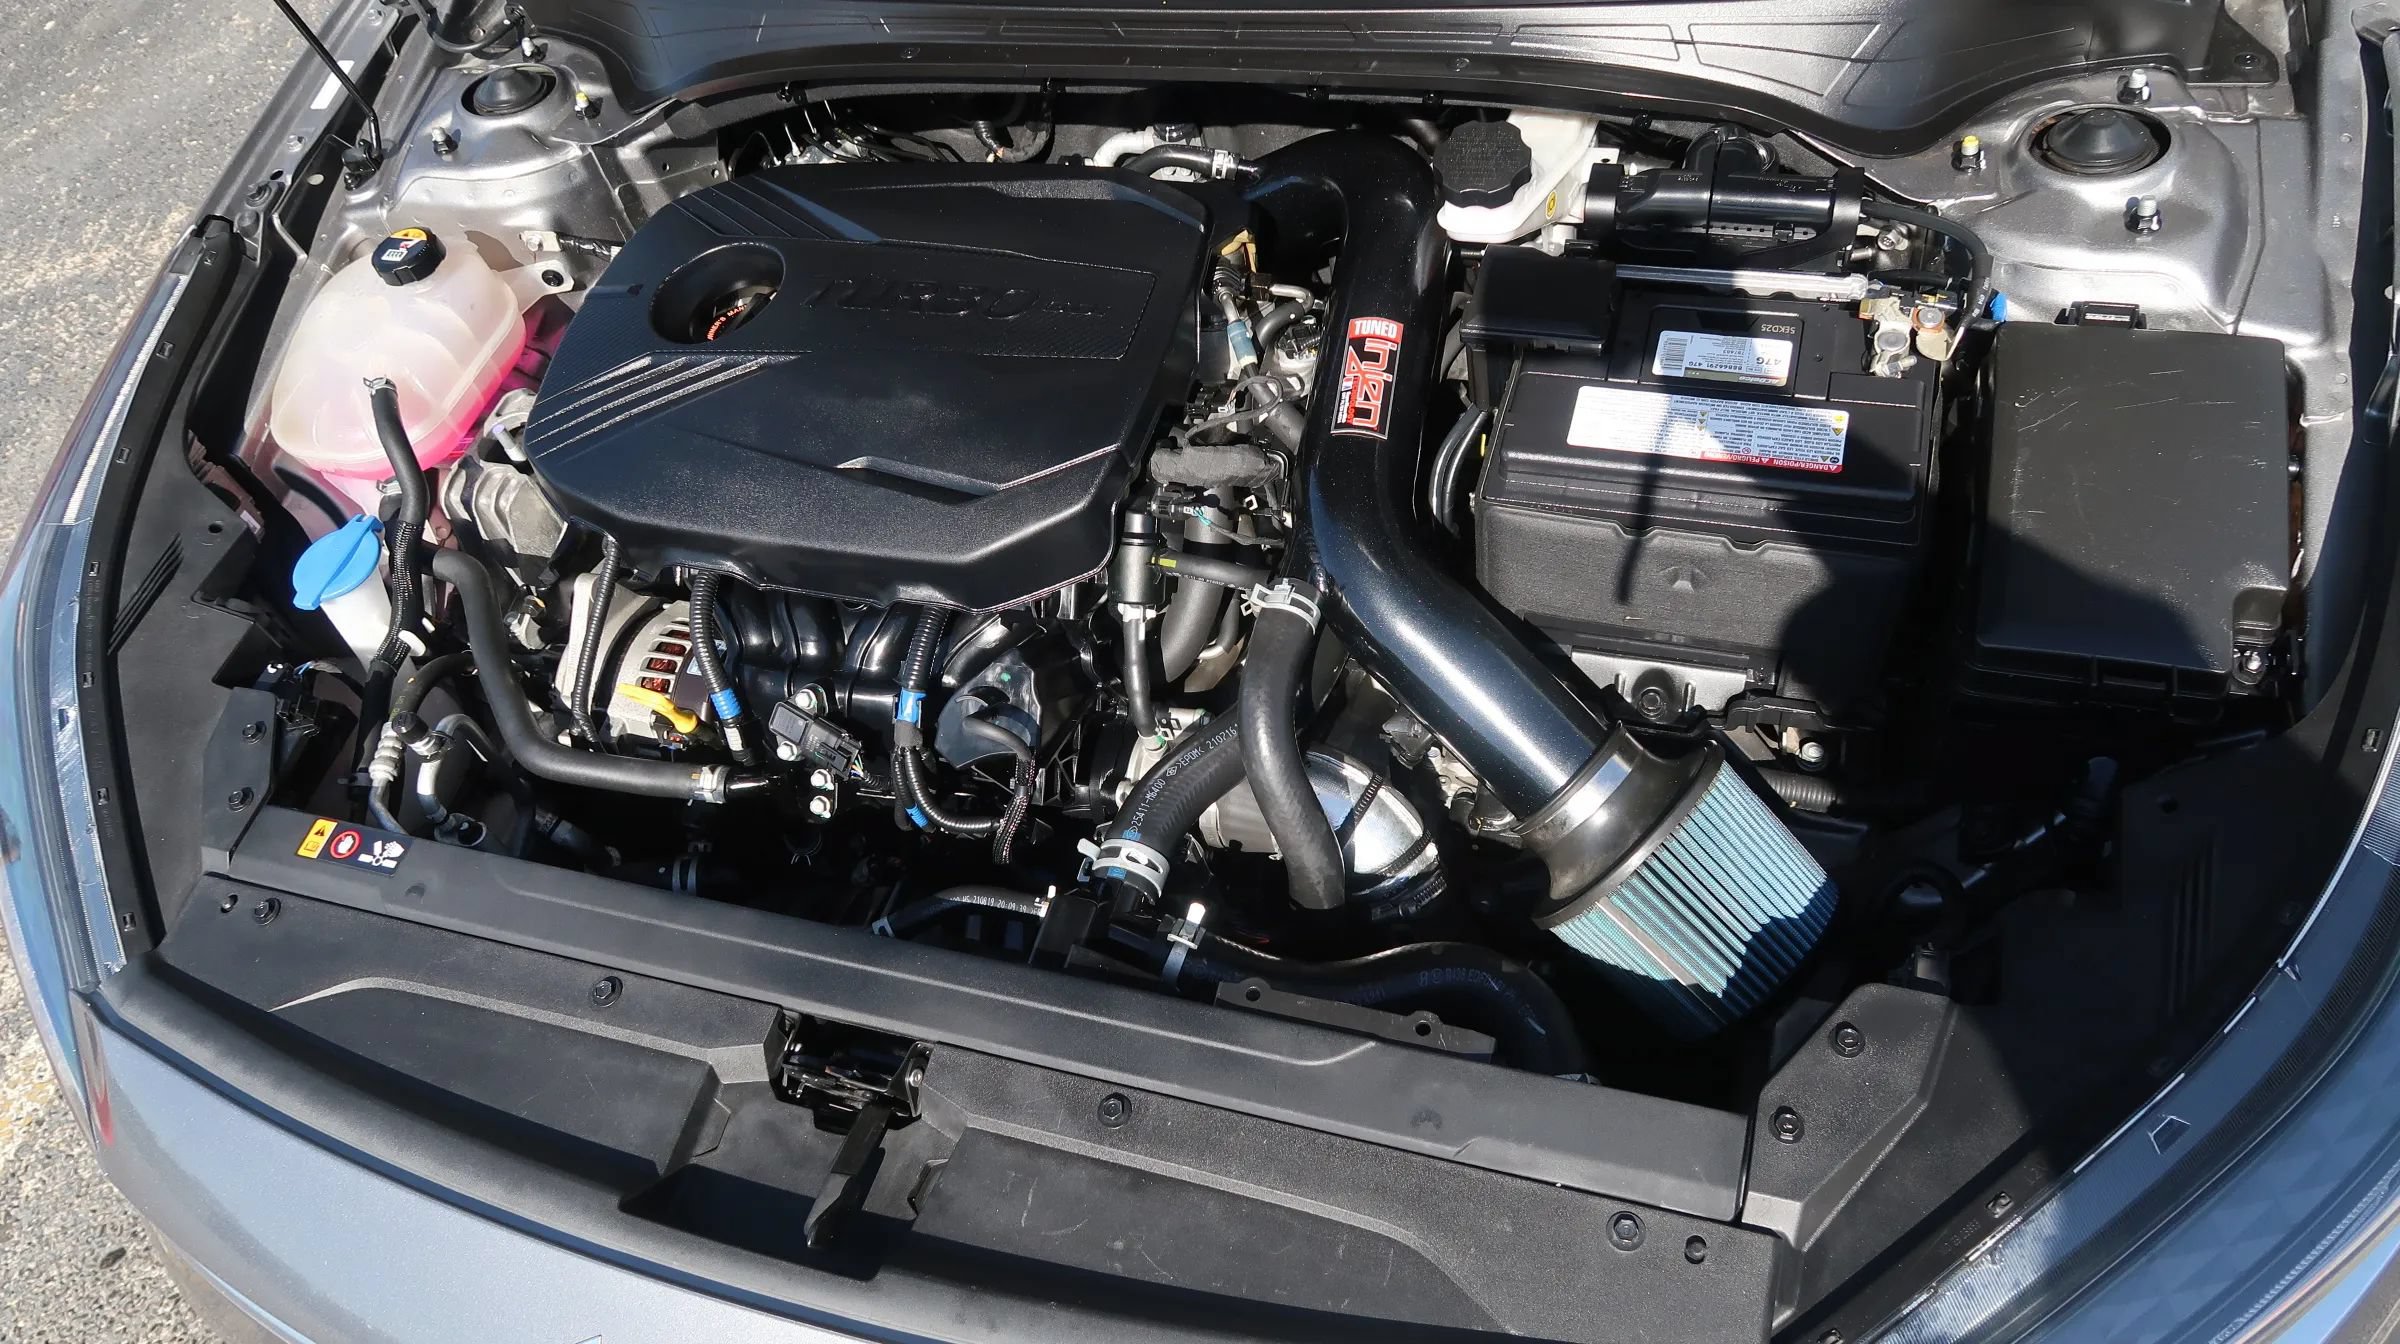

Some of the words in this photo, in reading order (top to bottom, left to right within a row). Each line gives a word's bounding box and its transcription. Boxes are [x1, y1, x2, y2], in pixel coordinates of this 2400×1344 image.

[1354, 319, 1398, 339] TUNED
[1344, 337, 1398, 428] injen
[1773, 459, 1829, 471] DANGER/POISON
